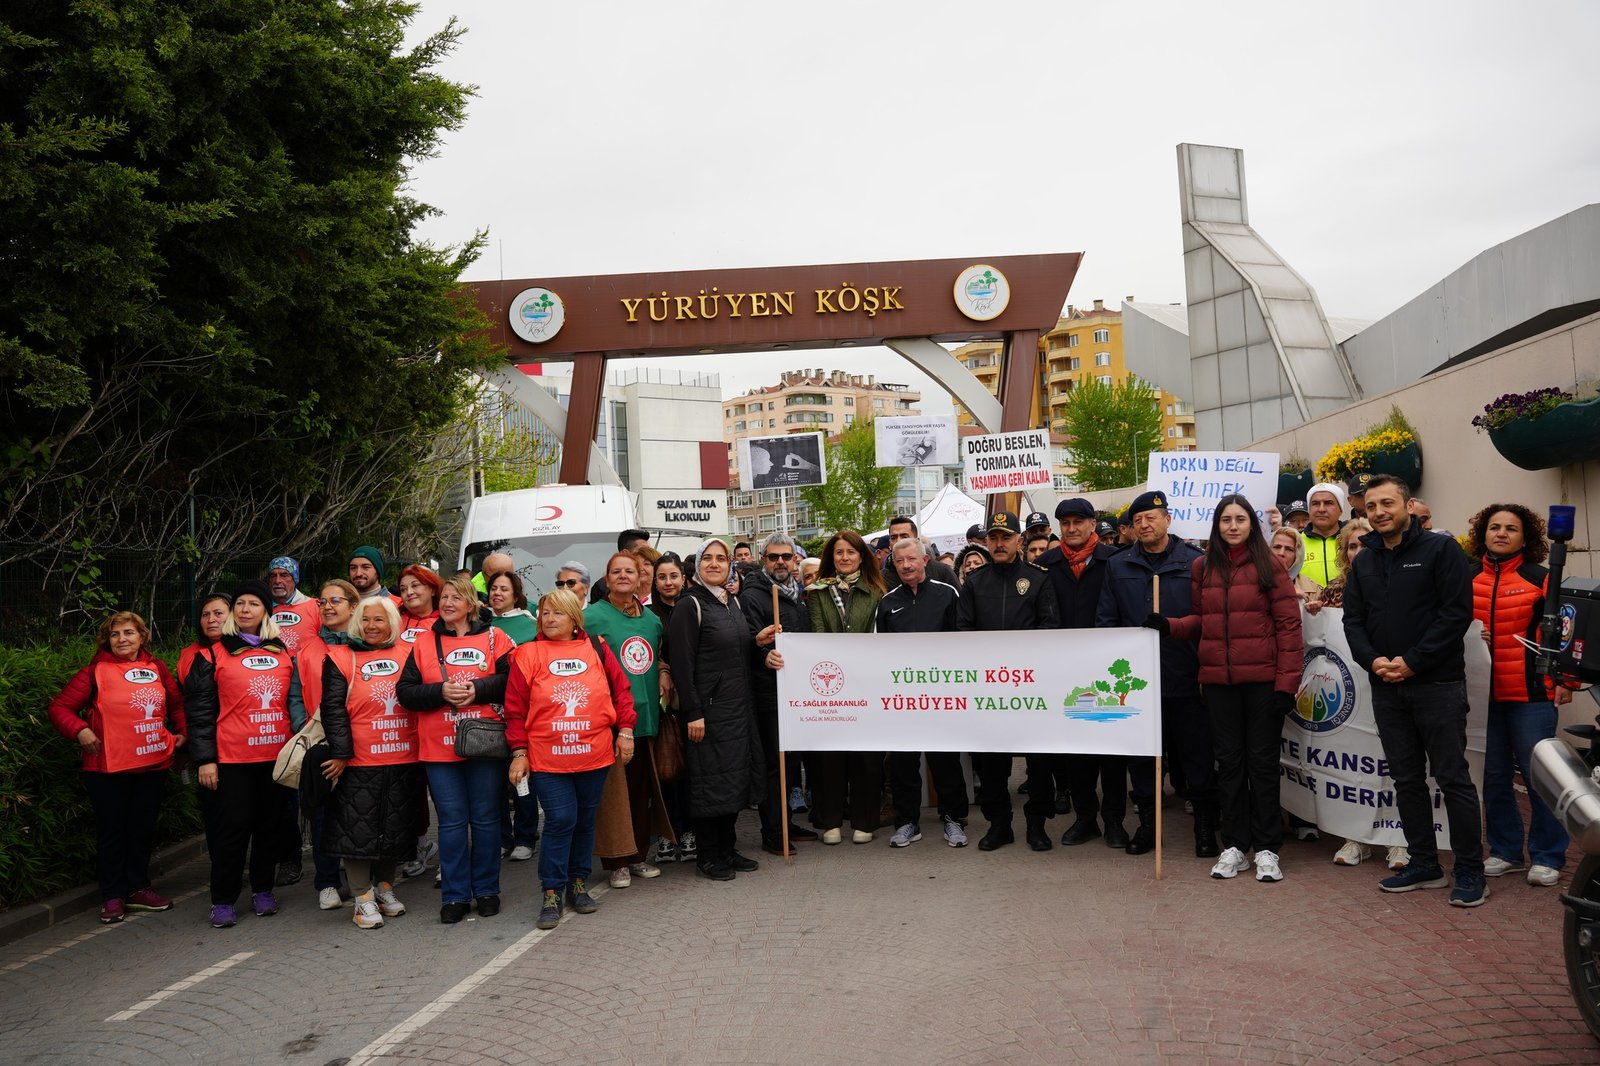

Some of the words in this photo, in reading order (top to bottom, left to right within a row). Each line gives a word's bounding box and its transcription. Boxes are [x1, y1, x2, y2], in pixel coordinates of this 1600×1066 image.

[621, 287, 795, 322] YÜRÜYEN
[815, 282, 905, 317] KÖŞK
[968, 436, 1002, 454] DOĞRU
[1005, 434, 1046, 451] BESLEN,
[976, 455, 1016, 472] FORMDA
[1019, 453, 1042, 469] KAL,
[1160, 457, 1208, 473] KORKU
[970, 474, 1007, 493] YAŞAMDAN
[1008, 469, 1025, 488] GERİ
[1026, 470, 1050, 485] KALMA
[657, 500, 688, 509] SUZAN
[691, 499, 716, 508] TUNA
[665, 512, 710, 522] İLKOKULU
[454, 651, 474, 659] TEMA
[368, 662, 389, 671] TEMA
[891, 667, 978, 683] YÜRÜYEN
[985, 667, 1035, 687] KÖŞK
[803, 699, 828, 707] SAĞLIK
[829, 699, 868, 707] BAKANLIĞI
[881, 694, 967, 710] YÜRÜYEN
[974, 697, 1048, 710] YALOVA
[249, 711, 284, 723] TÜRKİYE
[259, 724, 276, 734] ÇÖL
[371, 718, 409, 730] TÜRKİYE
[552, 719, 591, 731] TÜRKİYE
[146, 732, 160, 744] ÇÖL
[248, 734, 286, 746] OLMASIN
[382, 730, 400, 742] ÇÖL
[562, 732, 580, 744] ÇÖL
[370, 742, 410, 754] OLMASIN
[552, 744, 591, 755] OLMASIN
